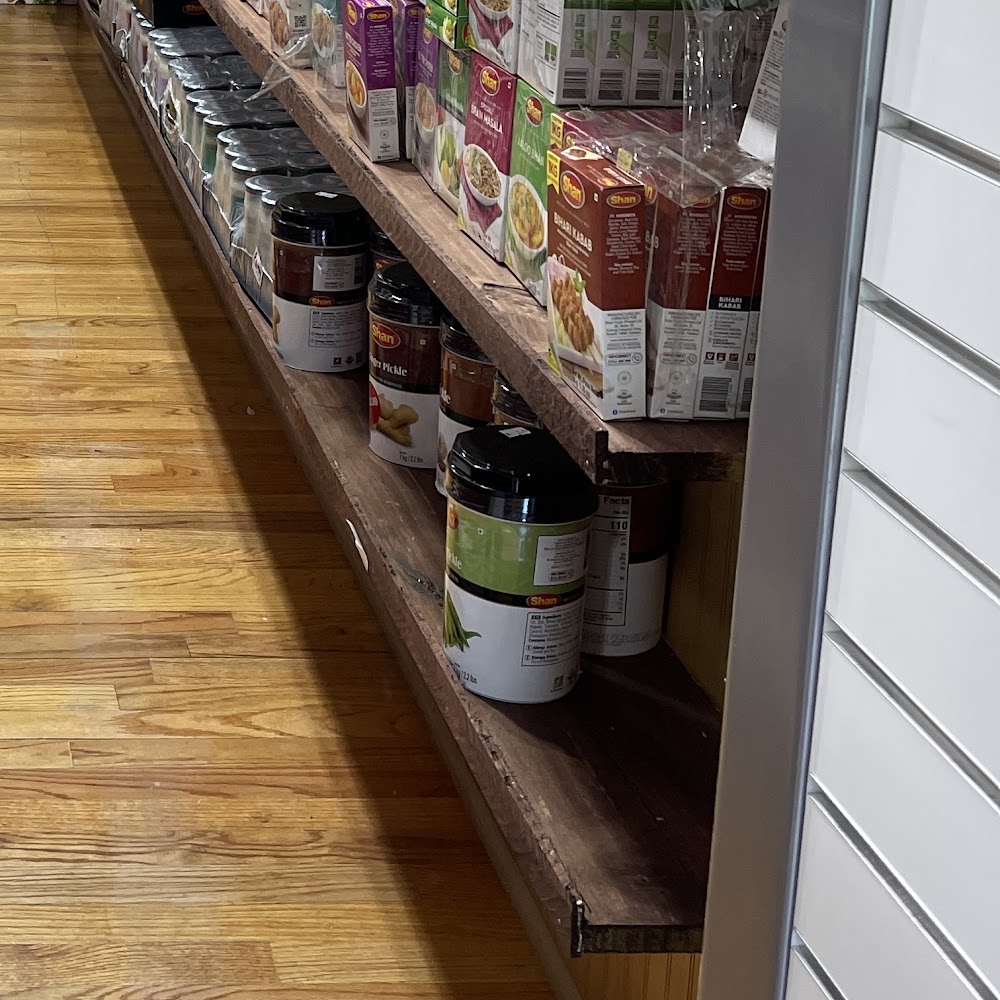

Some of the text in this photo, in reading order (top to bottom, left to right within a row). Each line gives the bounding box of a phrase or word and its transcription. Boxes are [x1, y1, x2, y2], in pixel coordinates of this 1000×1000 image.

[481, 70, 497, 91] Shan
[526, 98, 542, 121] Shan
[470, 104, 503, 134] BRAIN MASALA
[552, 124, 561, 138] 1KG
[548, 160, 558, 177] 1KG
[562, 175, 582, 202] Shan
[610, 195, 636, 204] Shan
[731, 196, 756, 206] Shan
[553, 212, 572, 236] BIHARI
[571, 226, 593, 252] KABAB
[311, 298, 332, 306] Shan
[372, 323, 395, 345] Shan
[382, 361, 408, 377] Pickle
[604, 496, 630, 504] Facts
[610, 520, 628, 530] 110
[531, 596, 557, 606] Shan
